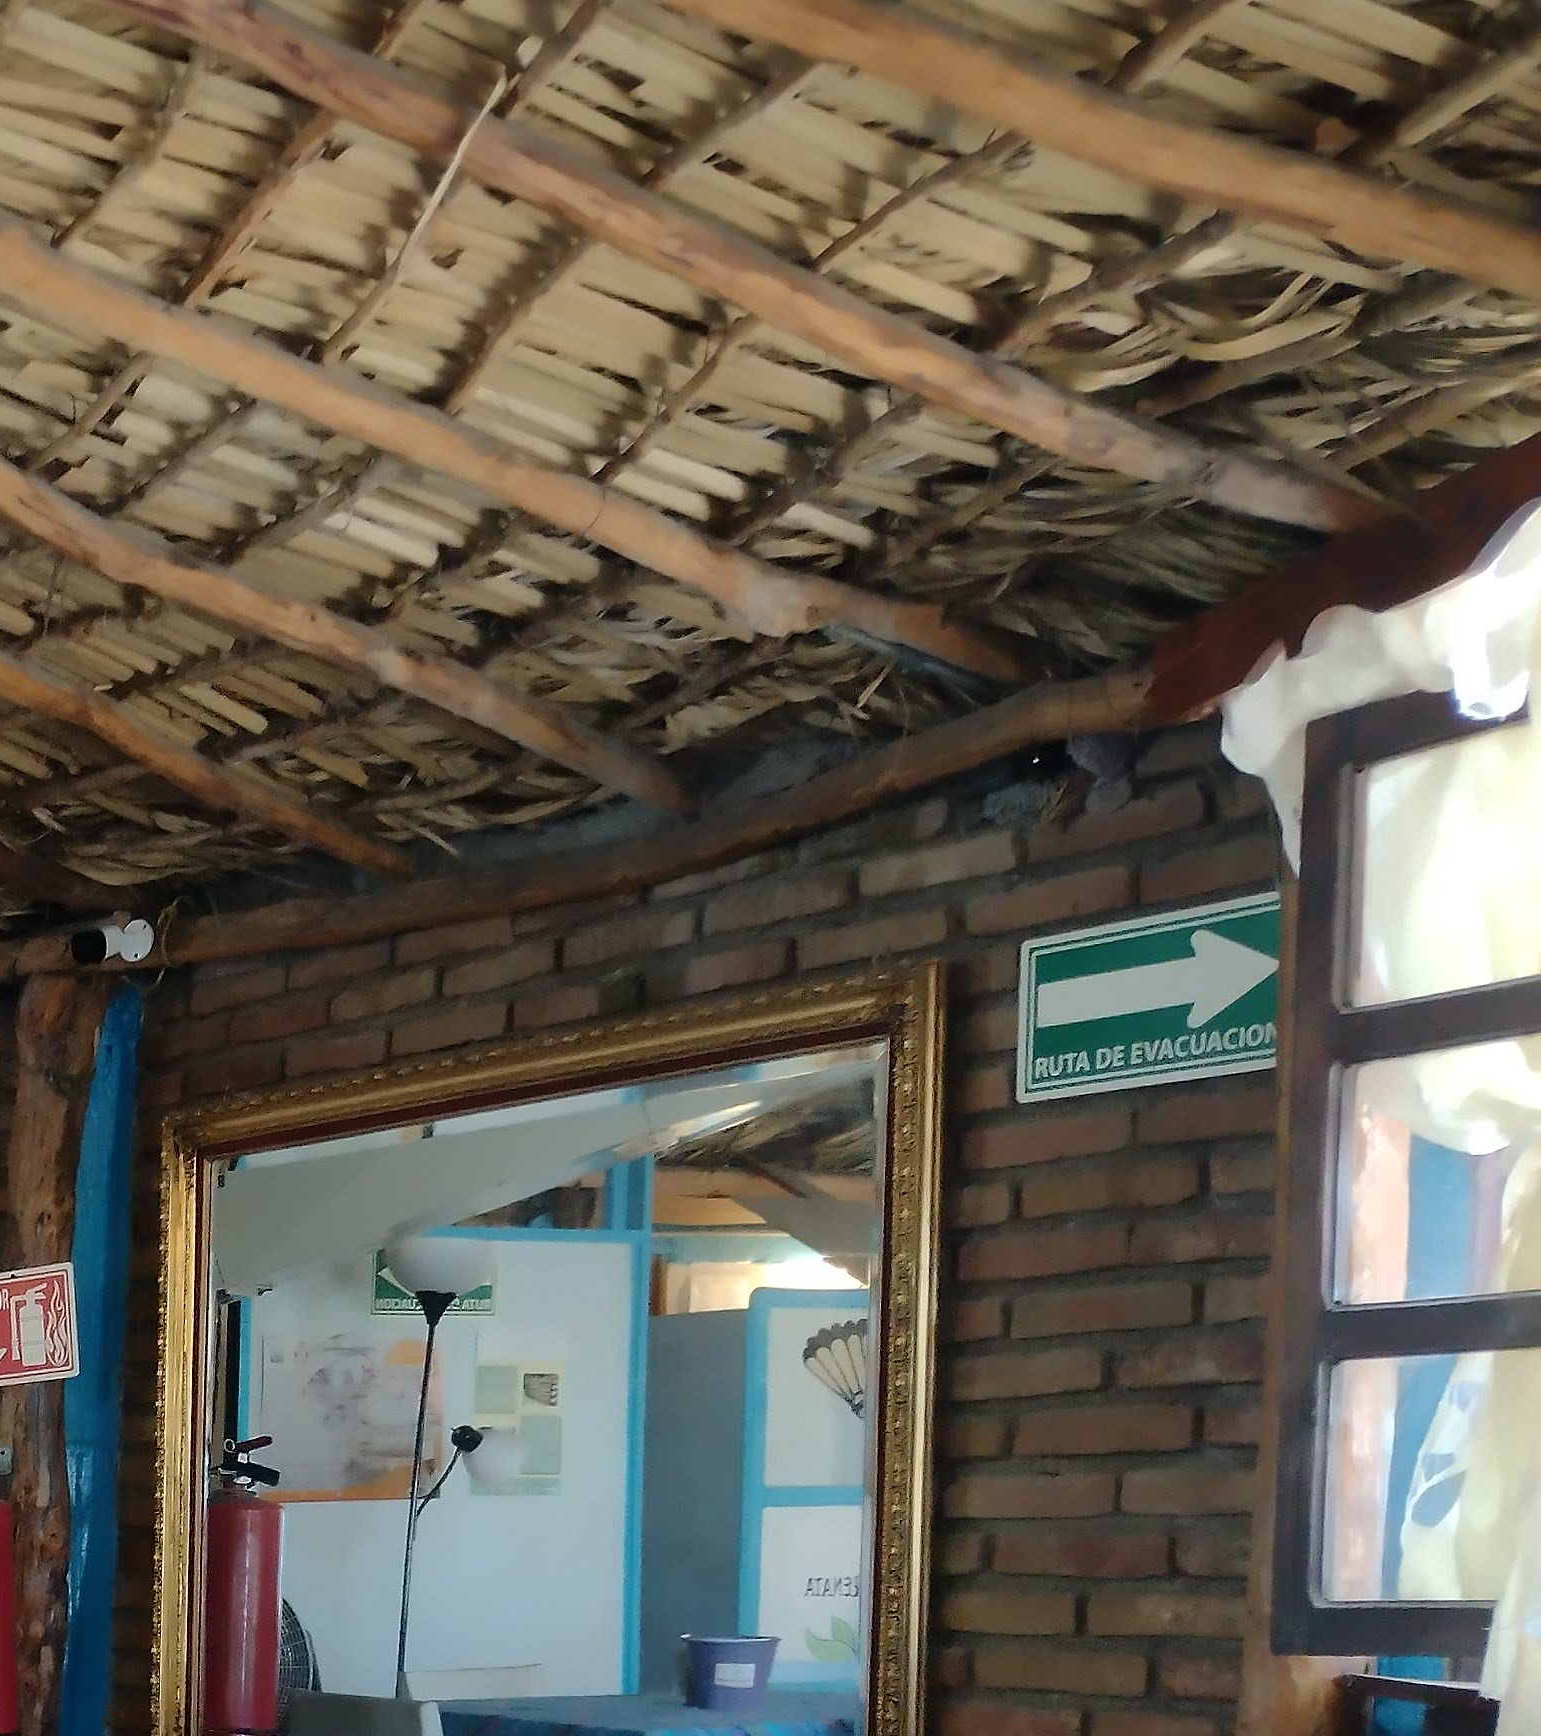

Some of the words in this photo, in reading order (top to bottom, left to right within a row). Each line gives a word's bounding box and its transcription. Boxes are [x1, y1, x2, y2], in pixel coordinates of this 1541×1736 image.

[1034, 1049, 1091, 1080] RUTA
[1095, 1044, 1125, 1071] DE
[1130, 1021, 1277, 1066] EVACUACION
